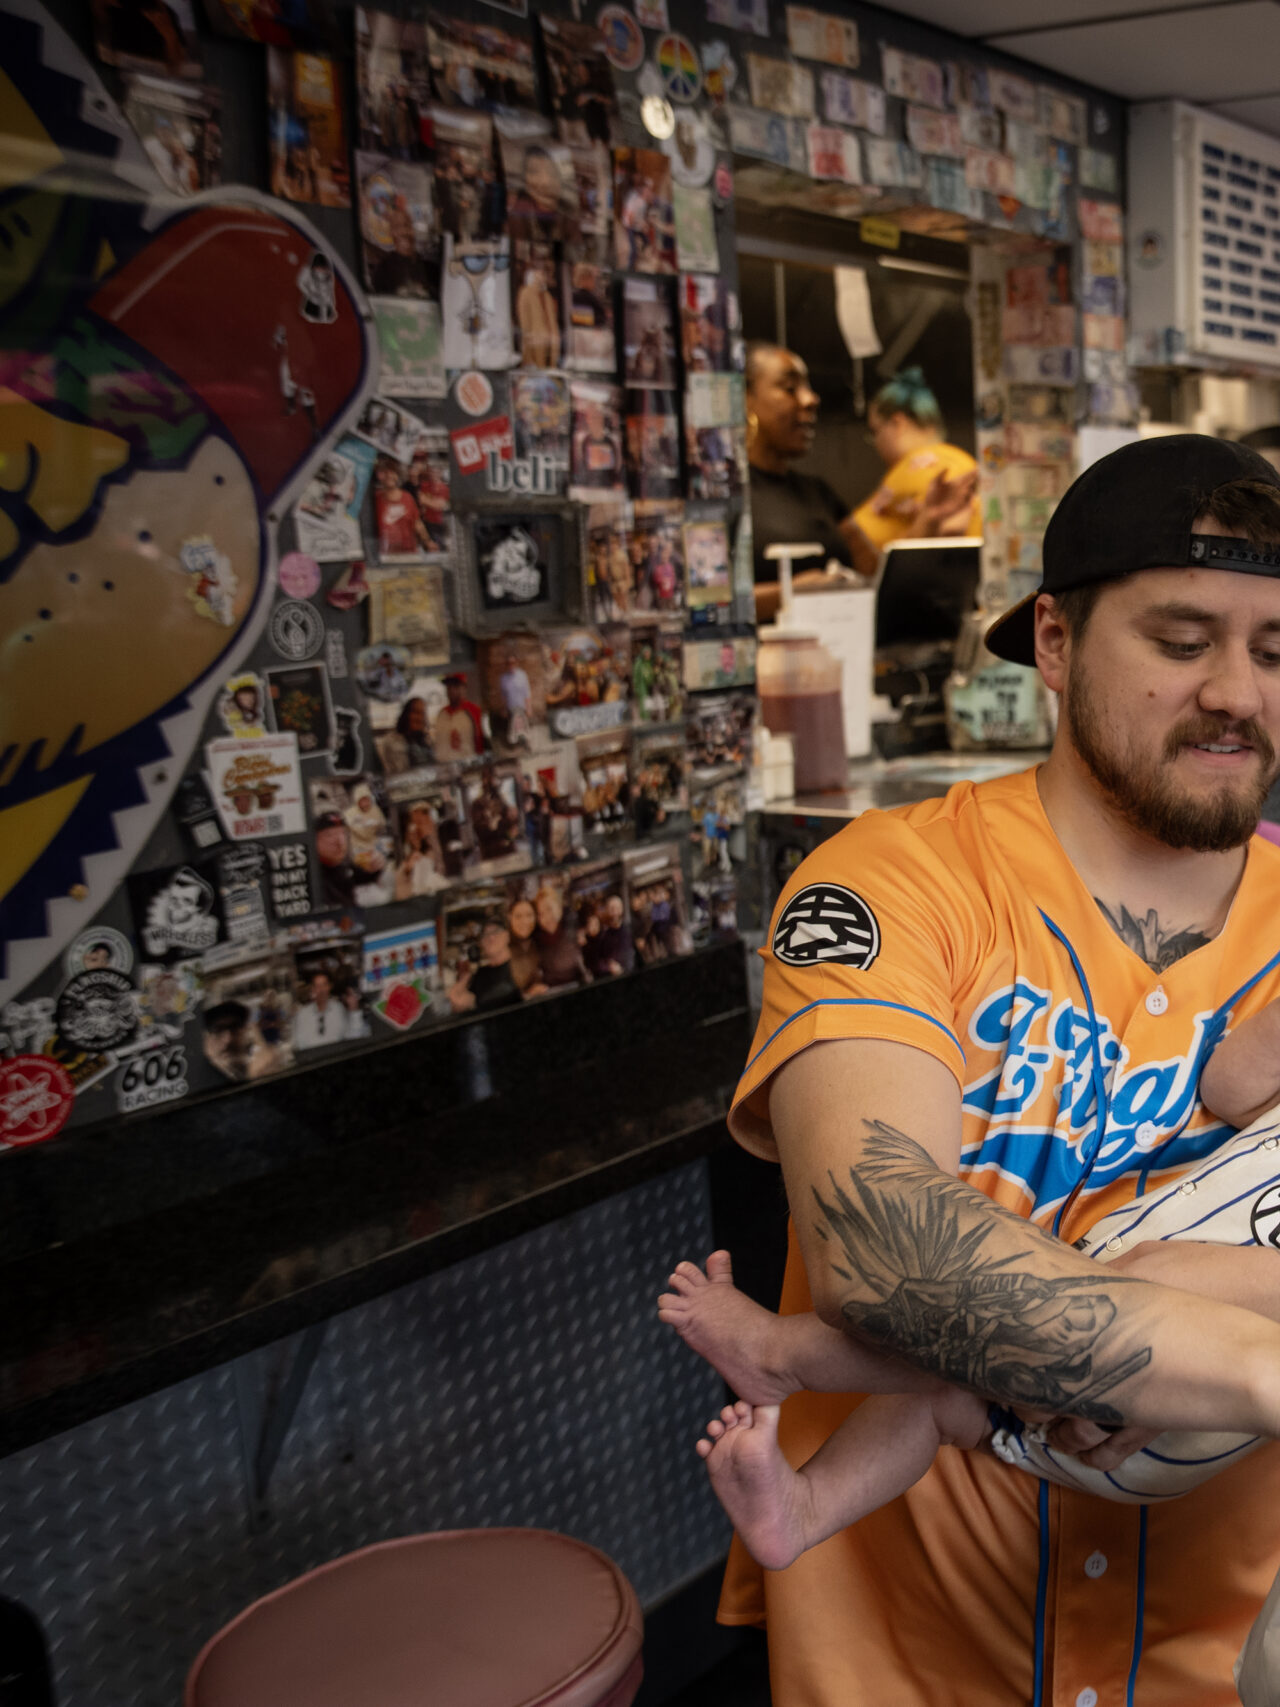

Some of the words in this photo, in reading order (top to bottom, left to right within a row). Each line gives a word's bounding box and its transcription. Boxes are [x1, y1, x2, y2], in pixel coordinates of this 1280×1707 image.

[267, 843, 307, 870] YES
[271, 871, 288, 887] IN
[289, 868, 308, 884] MY
[272, 884, 309, 903] BACK
[274, 899, 312, 918] YARD
[122, 1050, 182, 1092] 606
[125, 1080, 188, 1109] RACING
